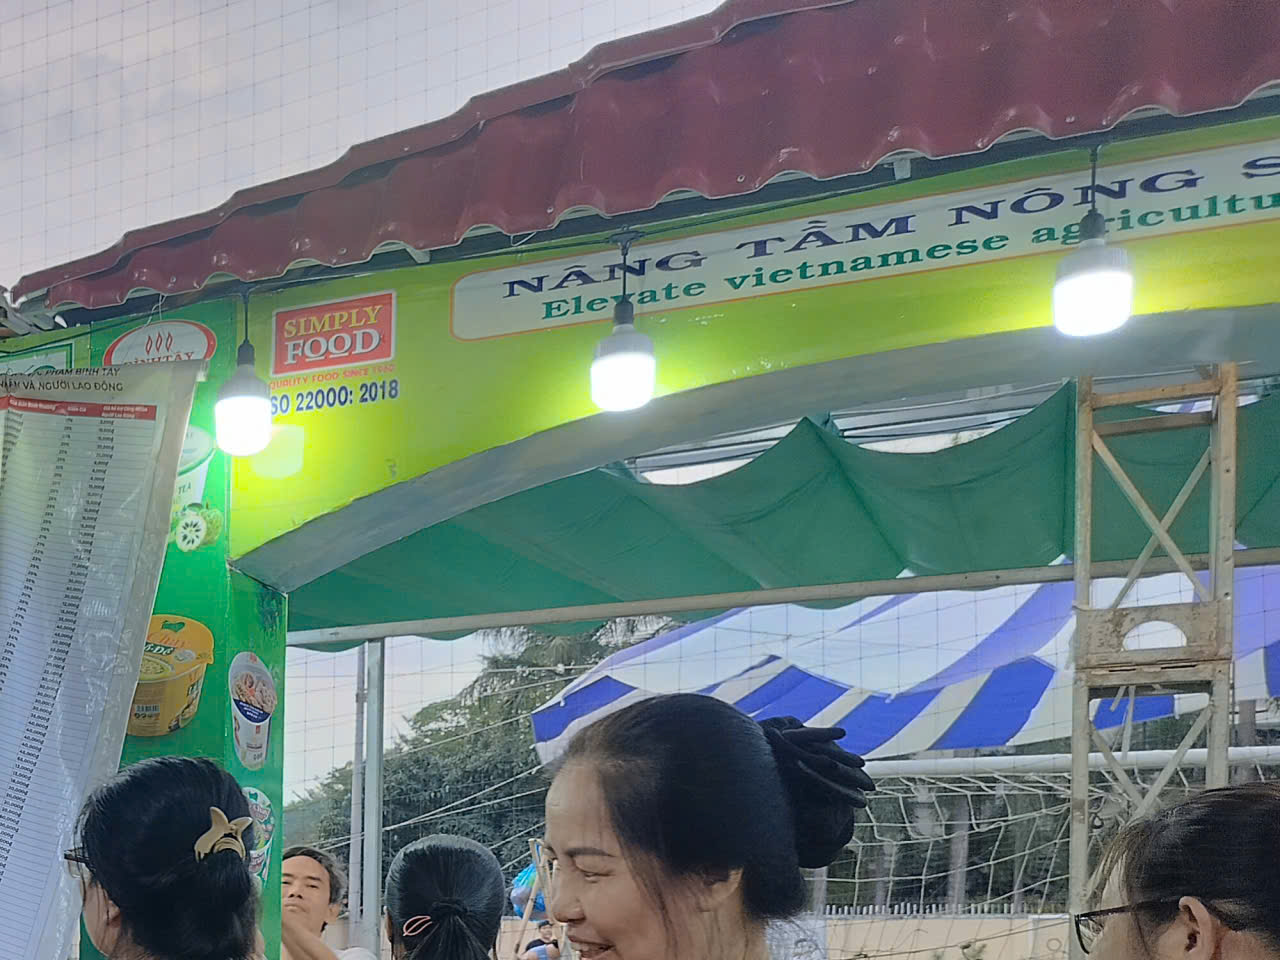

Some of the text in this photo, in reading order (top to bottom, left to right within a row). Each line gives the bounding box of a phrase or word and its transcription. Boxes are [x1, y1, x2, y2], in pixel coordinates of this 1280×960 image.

[503, 249, 708, 298] NÂNG
[735, 218, 917, 259] TẦM
[948, 169, 1205, 227] NÔNG
[724, 234, 1009, 290] vietnamese
[284, 305, 383, 338] SIMPLY
[284, 329, 382, 365] FOOD
[72, 380, 91, 391] LAO
[270, 377, 308, 390] QUALITY
[312, 372, 339, 384] FOOD
[343, 368, 368, 380] SINCE
[270, 379, 399, 415] SO 22000: 2018
